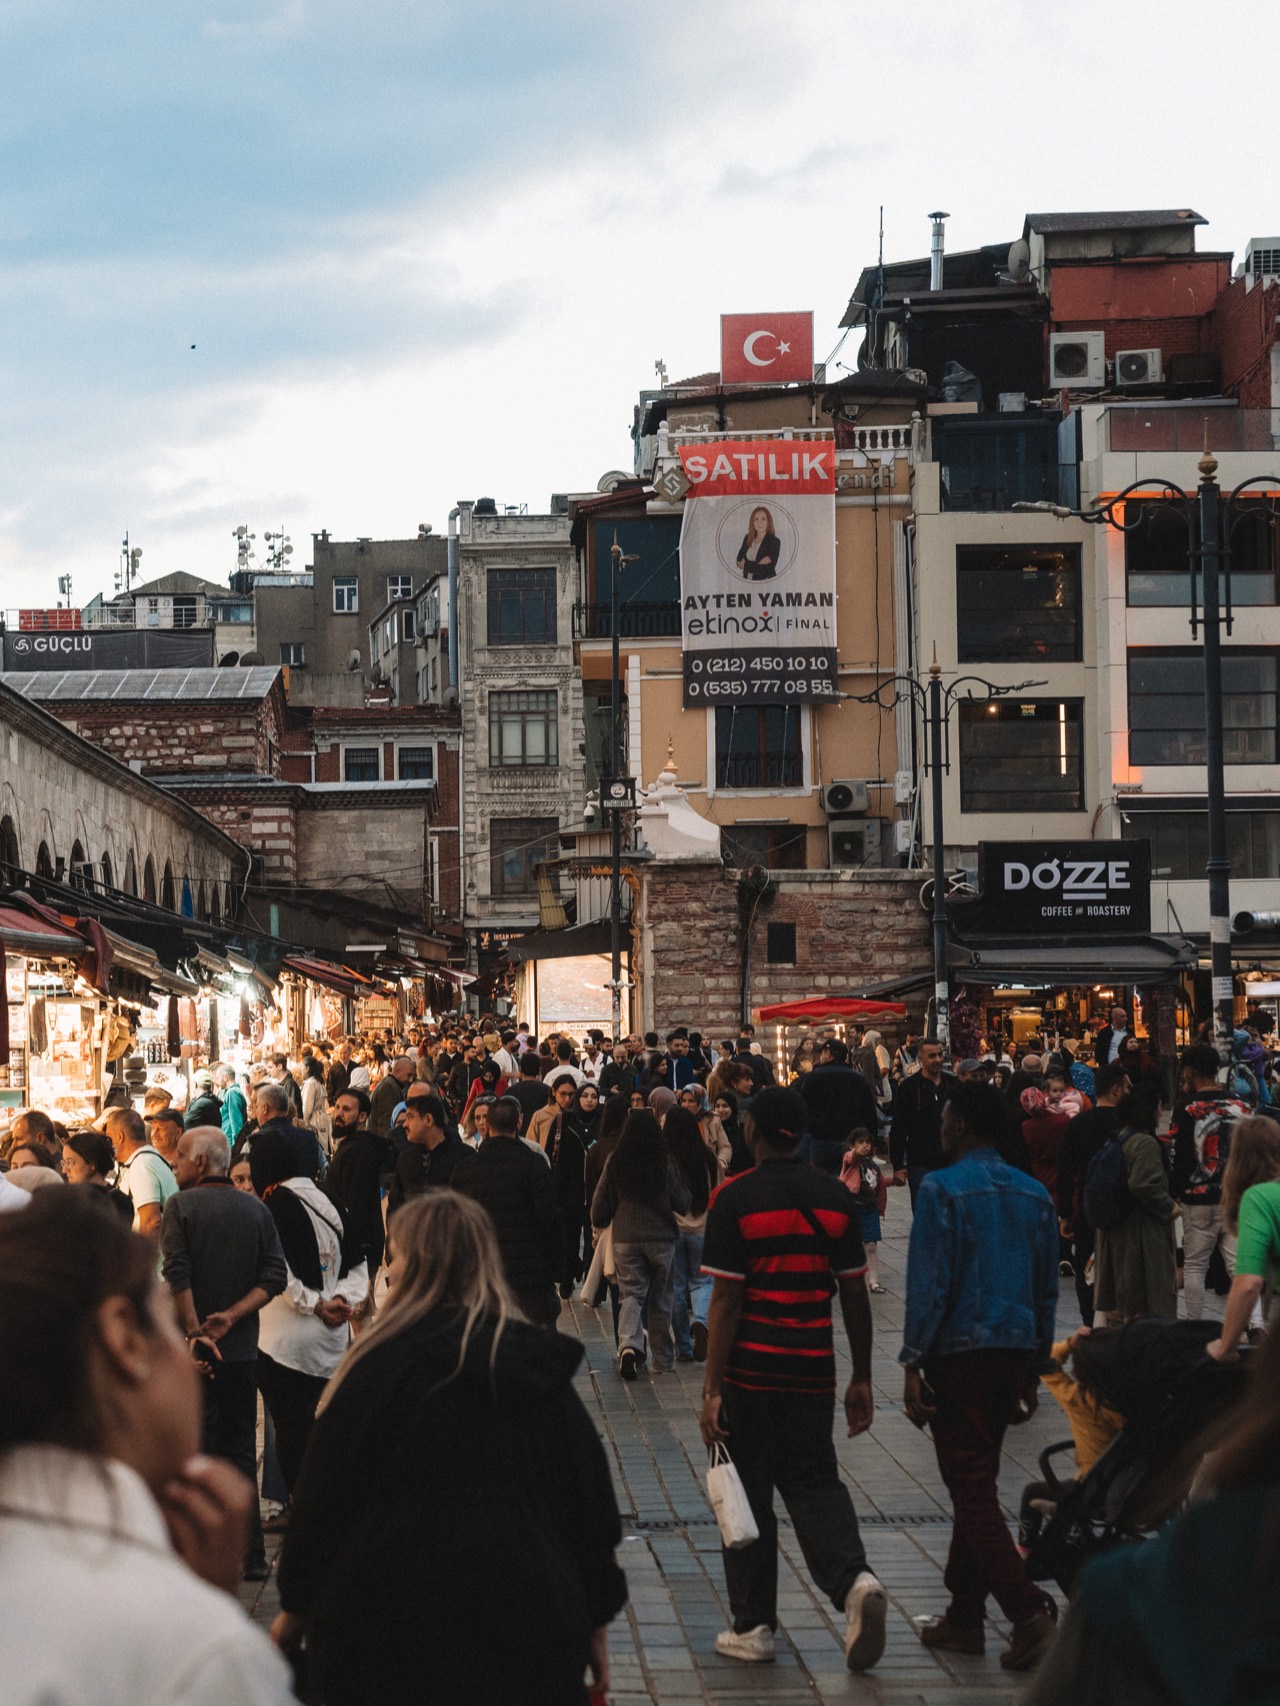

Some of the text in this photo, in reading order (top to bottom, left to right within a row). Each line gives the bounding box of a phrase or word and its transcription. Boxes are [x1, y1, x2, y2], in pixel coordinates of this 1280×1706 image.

[685, 452, 829, 484] SATILIK
[836, 465, 895, 489] endi
[685, 592, 834, 610] AYTEN YAMAN
[688, 610, 830, 635] ekinox FİNAL
[34, 635, 92, 654] GÜÇLÜ
[691, 656, 828, 674] 0 (212) 450 10 10
[688, 679, 833, 697] 0 (535) 777 08 55
[1041, 905, 1073, 917] COFFEE
[1087, 905, 1132, 916] ROASTERY
